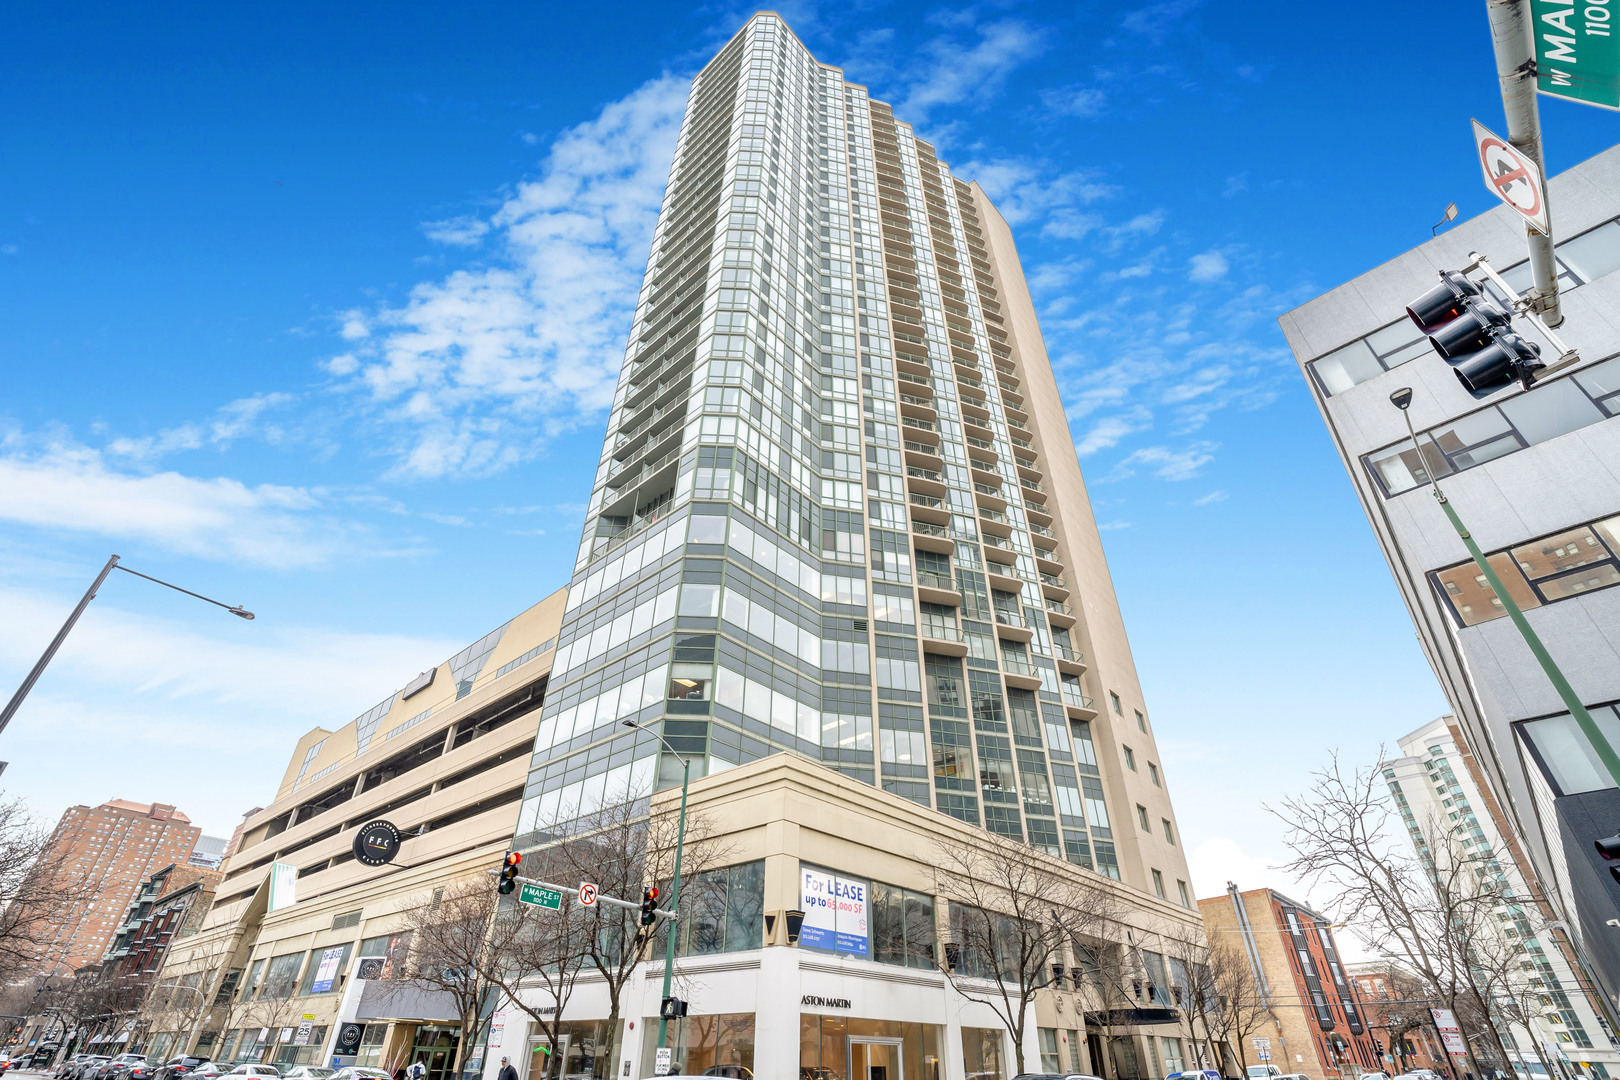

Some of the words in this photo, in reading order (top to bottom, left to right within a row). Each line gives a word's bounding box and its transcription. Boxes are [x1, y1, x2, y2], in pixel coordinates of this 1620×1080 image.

[1550, 68, 1572, 86] W
[368, 836, 390, 847] FFC
[528, 888, 553, 900] MAPLE
[806, 874, 824, 892] For
[828, 879, 864, 902] LEASE
[805, 895, 816, 907] up
[817, 896, 827, 907] to
[827, 898, 853, 913] 65,000
[853, 903, 864, 914] SF
[801, 995, 825, 1006] ASTON
[825, 997, 851, 1009] MARTIN
[298, 1028, 310, 1036] 25
